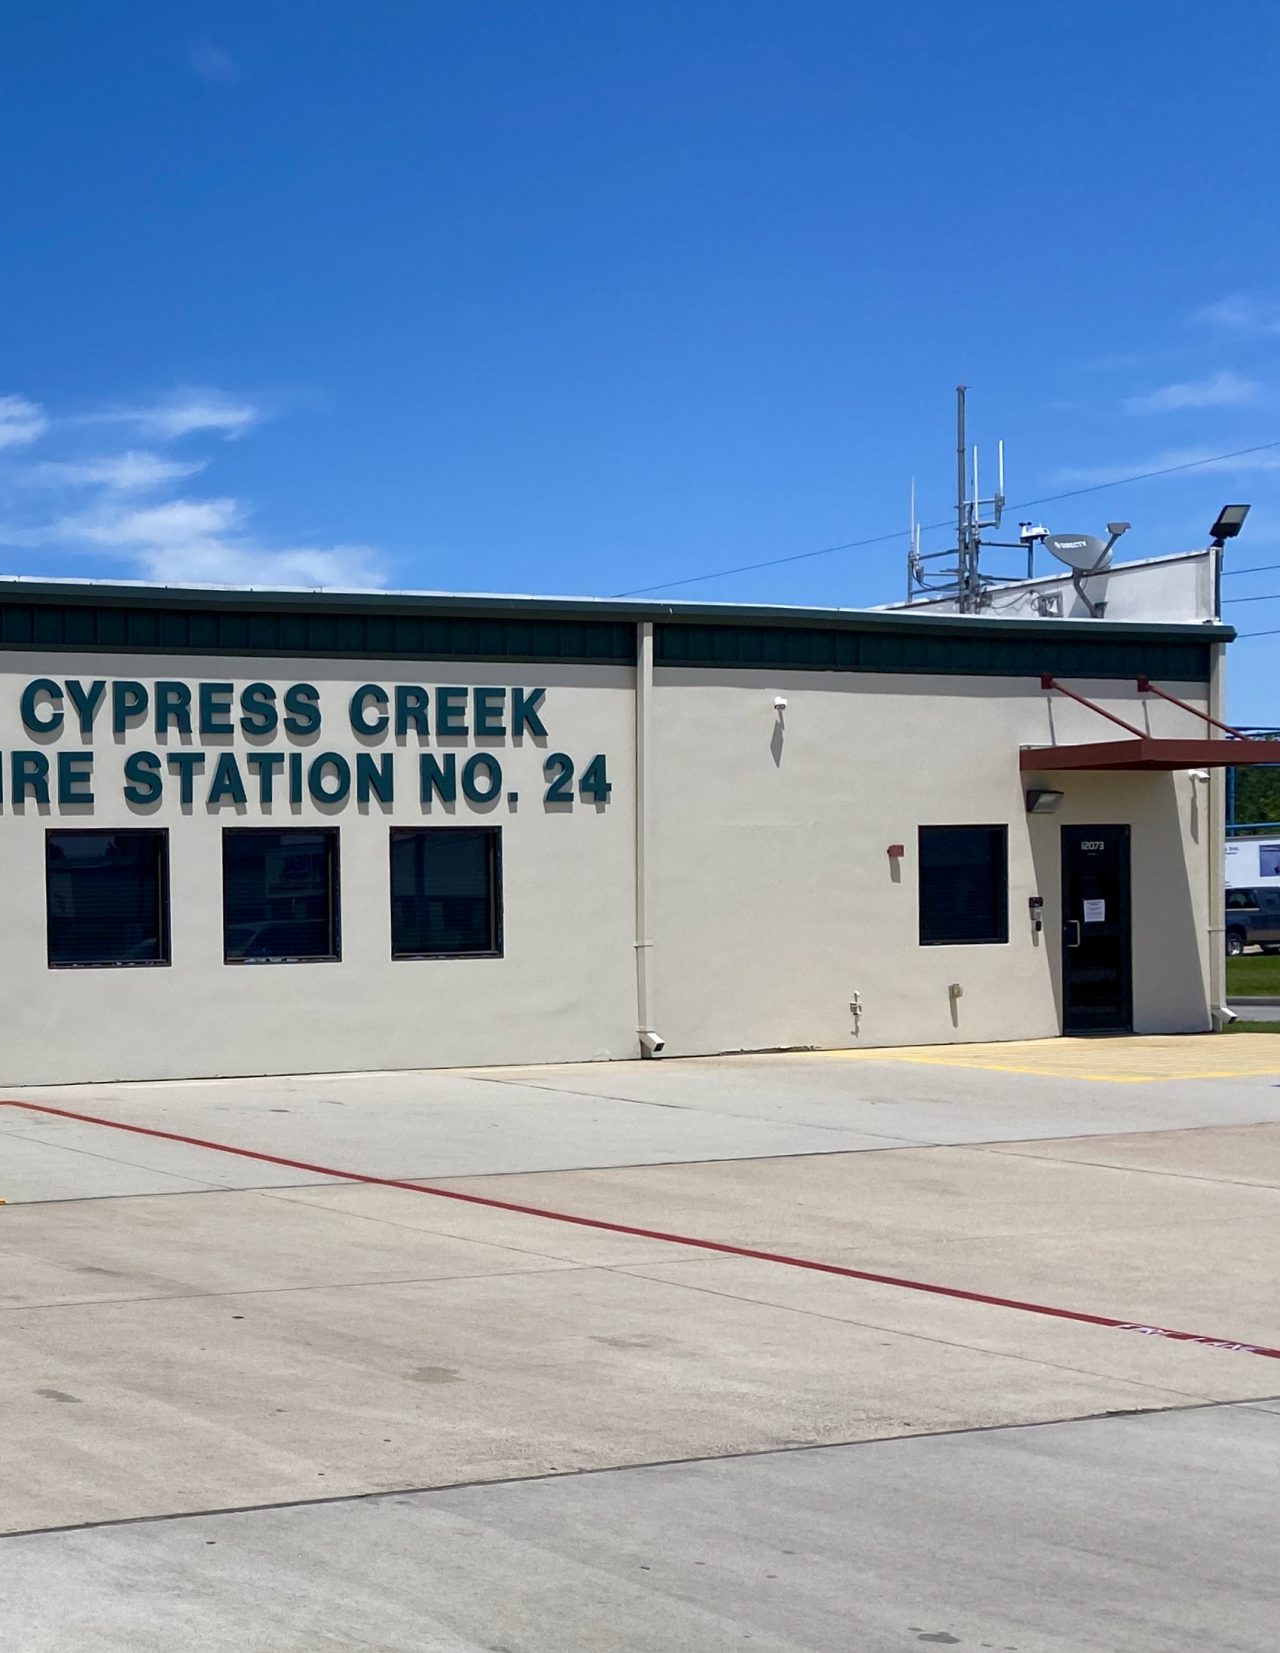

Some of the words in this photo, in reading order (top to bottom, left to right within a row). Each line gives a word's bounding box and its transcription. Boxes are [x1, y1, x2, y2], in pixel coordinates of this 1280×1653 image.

[20, 679, 323, 735] CYPRESS
[350, 684, 548, 737] CREEK
[123, 751, 394, 804] STATION
[420, 752, 518, 803] NO.
[544, 752, 612, 802] 24
